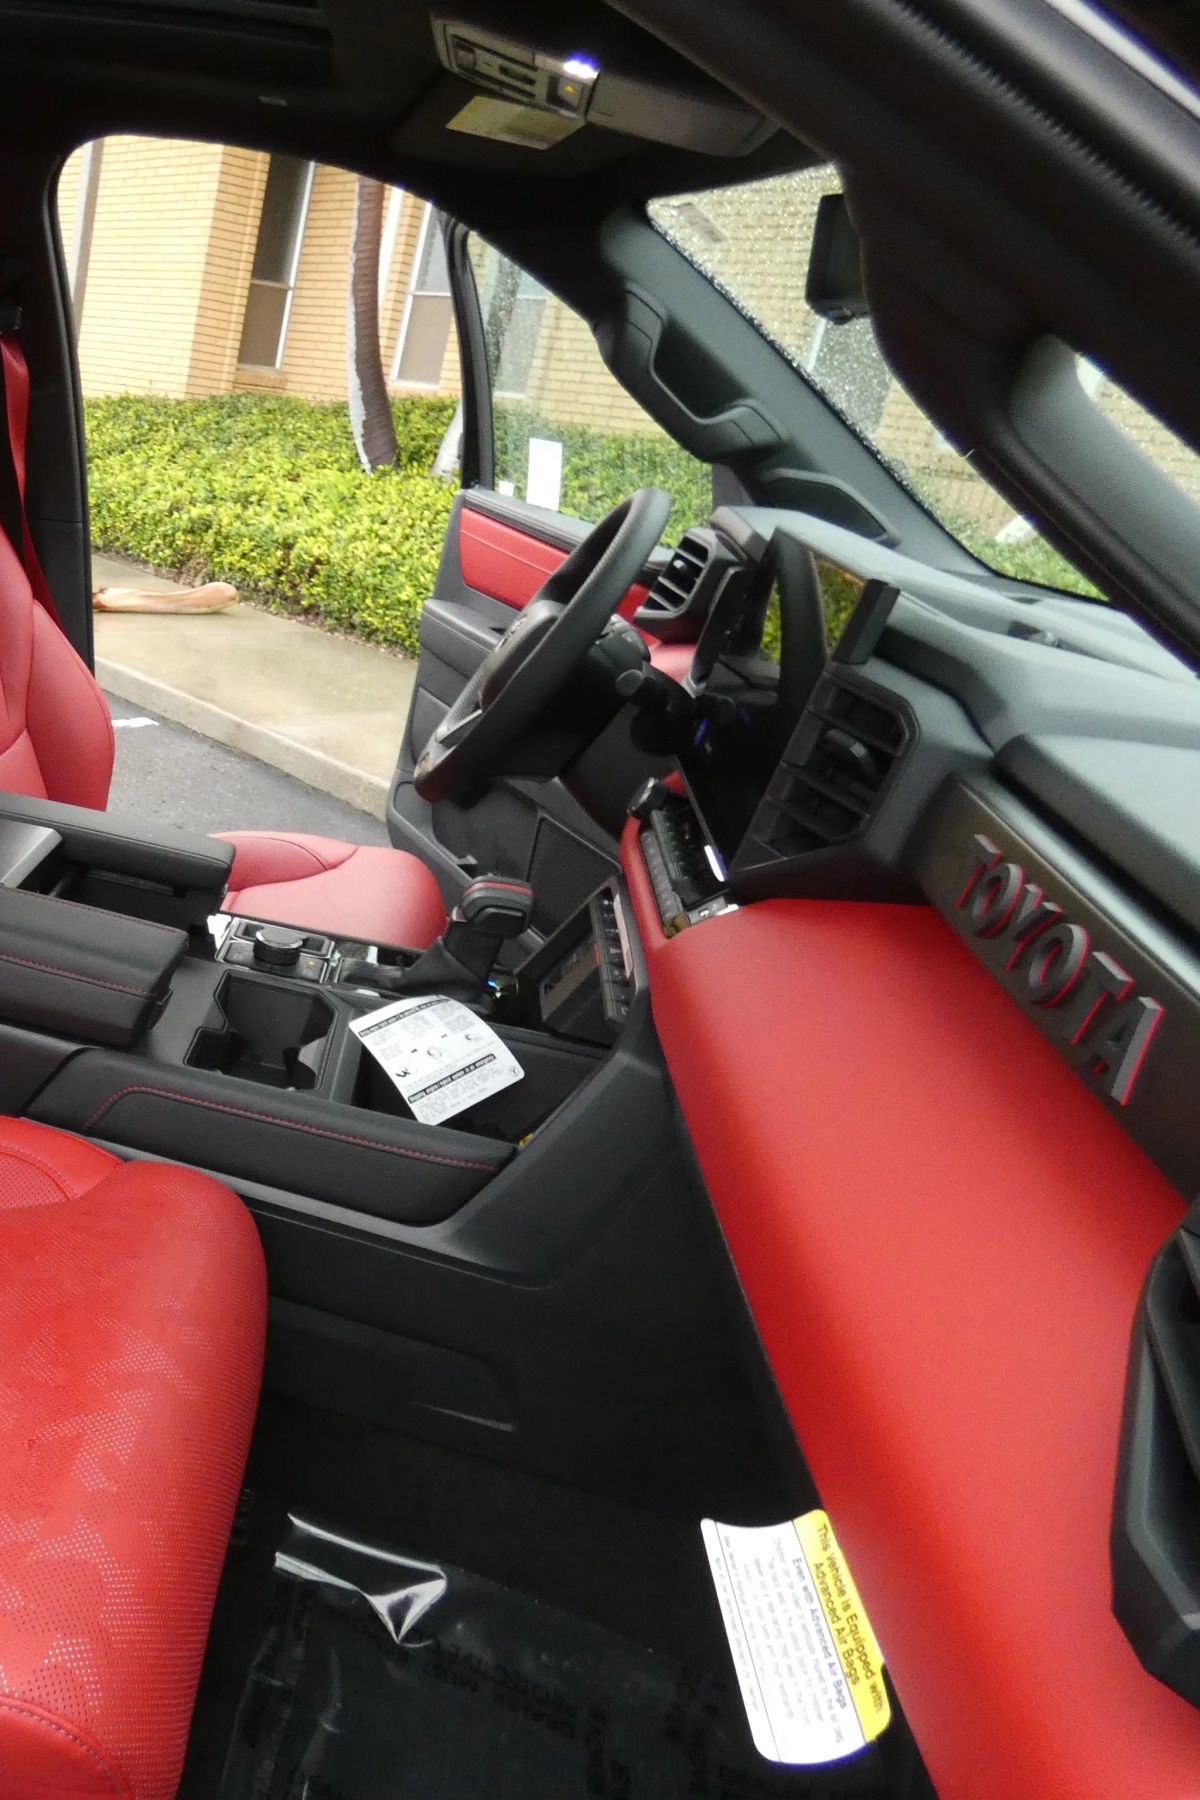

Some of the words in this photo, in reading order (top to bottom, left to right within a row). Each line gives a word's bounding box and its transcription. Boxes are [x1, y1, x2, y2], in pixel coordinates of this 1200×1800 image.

[955, 833, 1166, 1106] TOYOTA
[817, 1523, 831, 1551] This
[826, 1552, 847, 1597] Vehicle
[814, 1562, 842, 1624] Advanced
[835, 1626, 848, 1646] Air
[842, 1648, 860, 1685] Bags
[841, 1598, 852, 1612] is
[810, 1607, 832, 1659] Advanced
[828, 1662, 838, 1676] Air
[833, 1679, 847, 1709] Bags
[846, 1613, 876, 1680] Equipped
[869, 1681, 883, 1713] with
